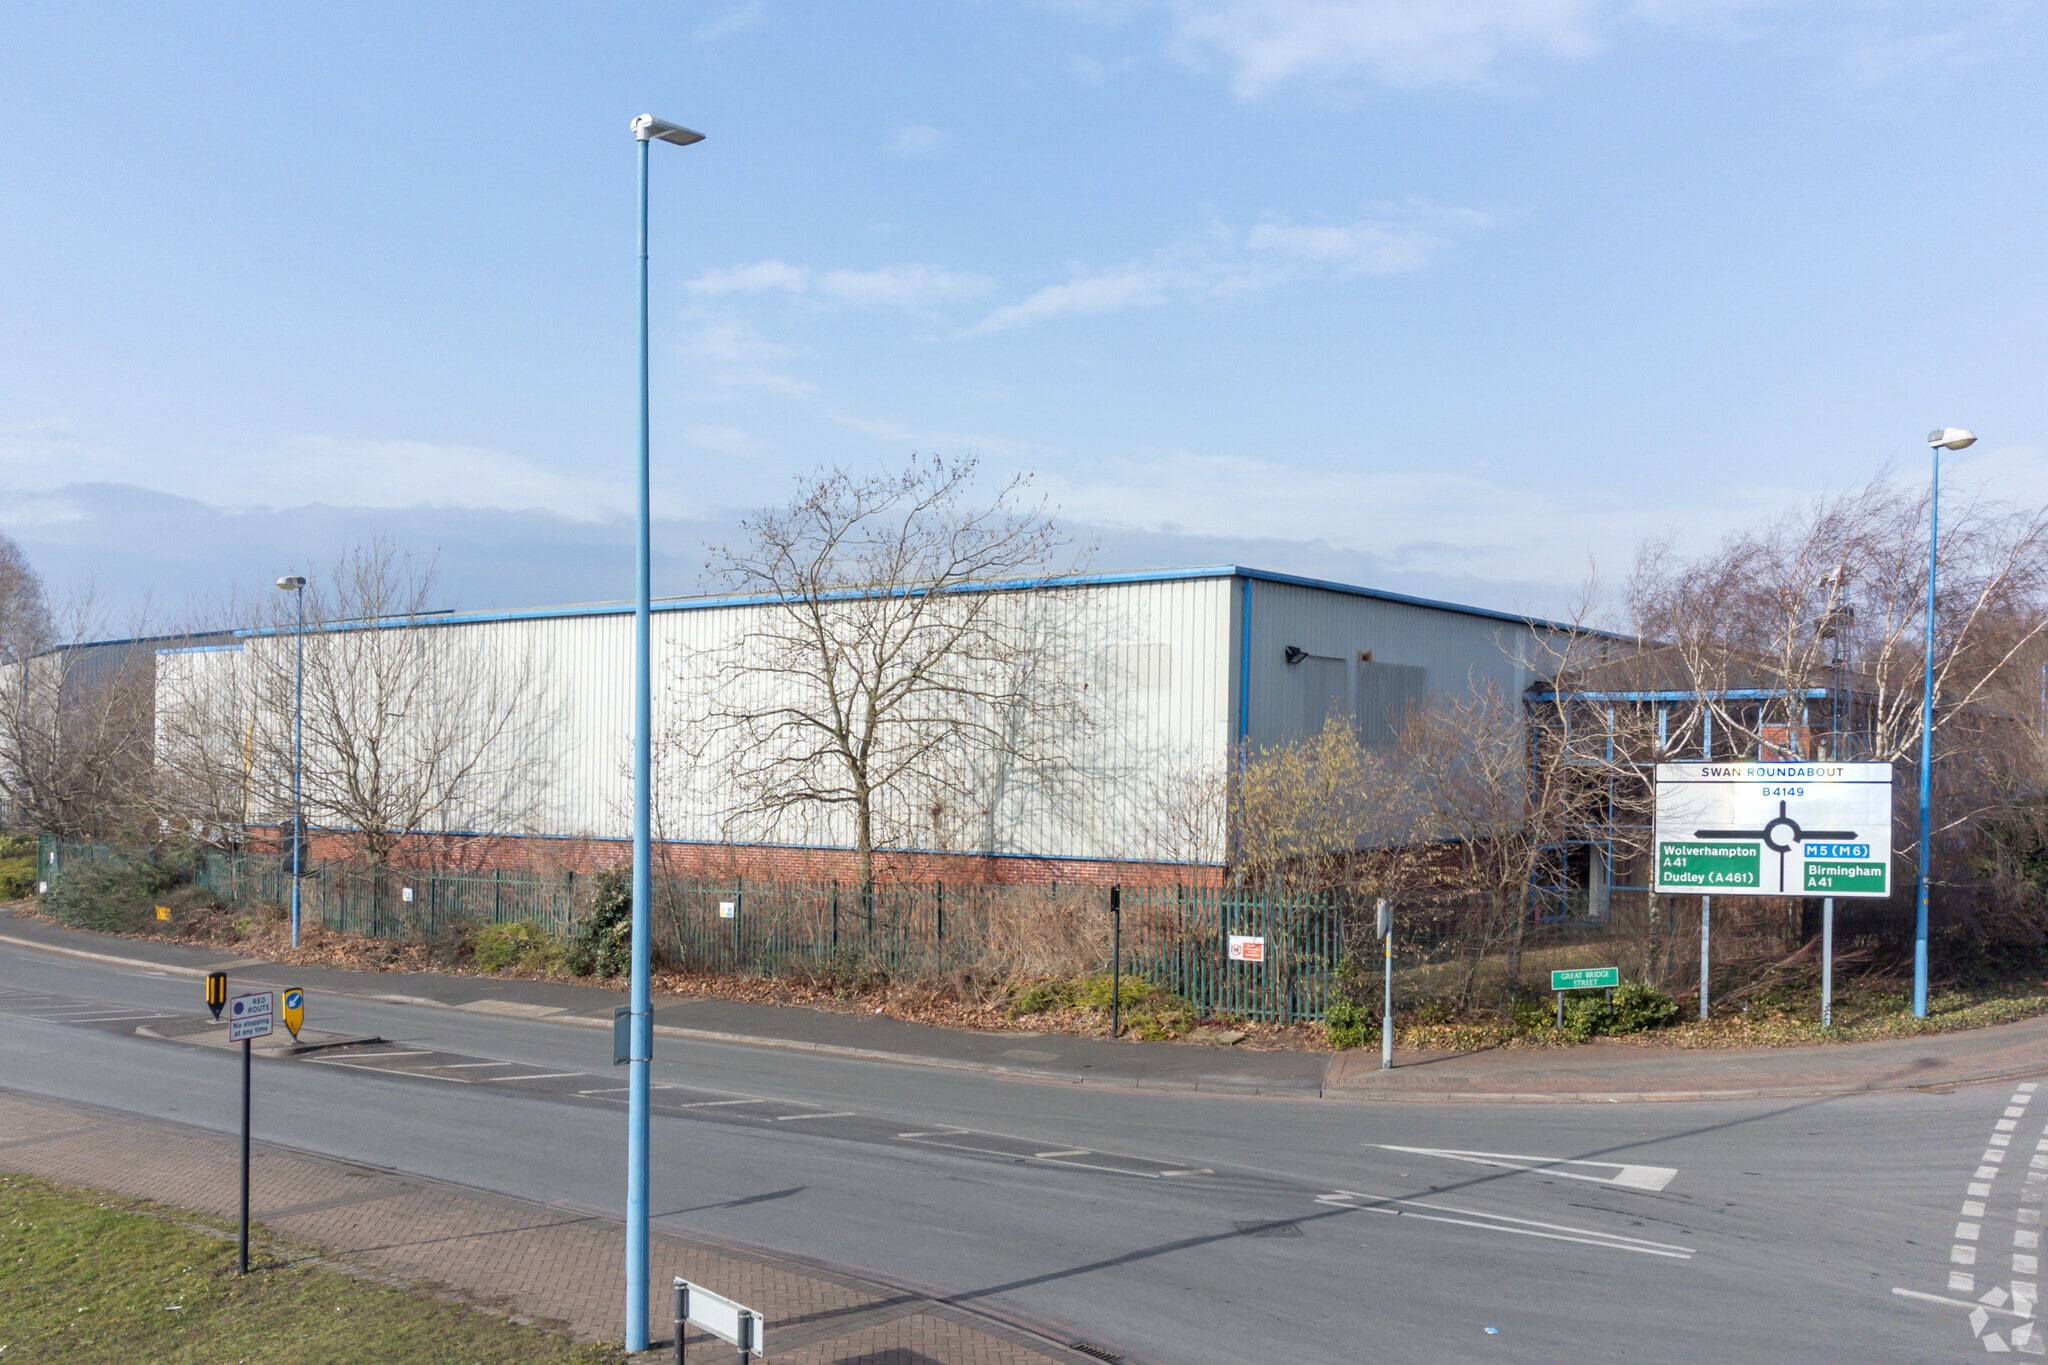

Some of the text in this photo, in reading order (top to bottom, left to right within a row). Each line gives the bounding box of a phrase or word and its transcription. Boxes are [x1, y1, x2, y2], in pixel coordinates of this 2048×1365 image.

[1701, 767, 1844, 777] SWAN ROUNDABOUT
[1762, 787, 1804, 797] B4149
[1663, 845, 1757, 859] Wolverhampton
[1663, 858, 1687, 868] A41
[1808, 865, 1882, 878] Birmingham
[1663, 872, 1754, 884] Dudley (A461)
[1808, 878, 1833, 888] A41
[1561, 970, 1609, 980] GREAT BRIDGE
[1573, 979, 1598, 987] STREET
[248, 1004, 270, 1013] ROUTE
[243, 1018, 270, 1027] stopping
[242, 1028, 253, 1036] any
[254, 1025, 268, 1033] time
